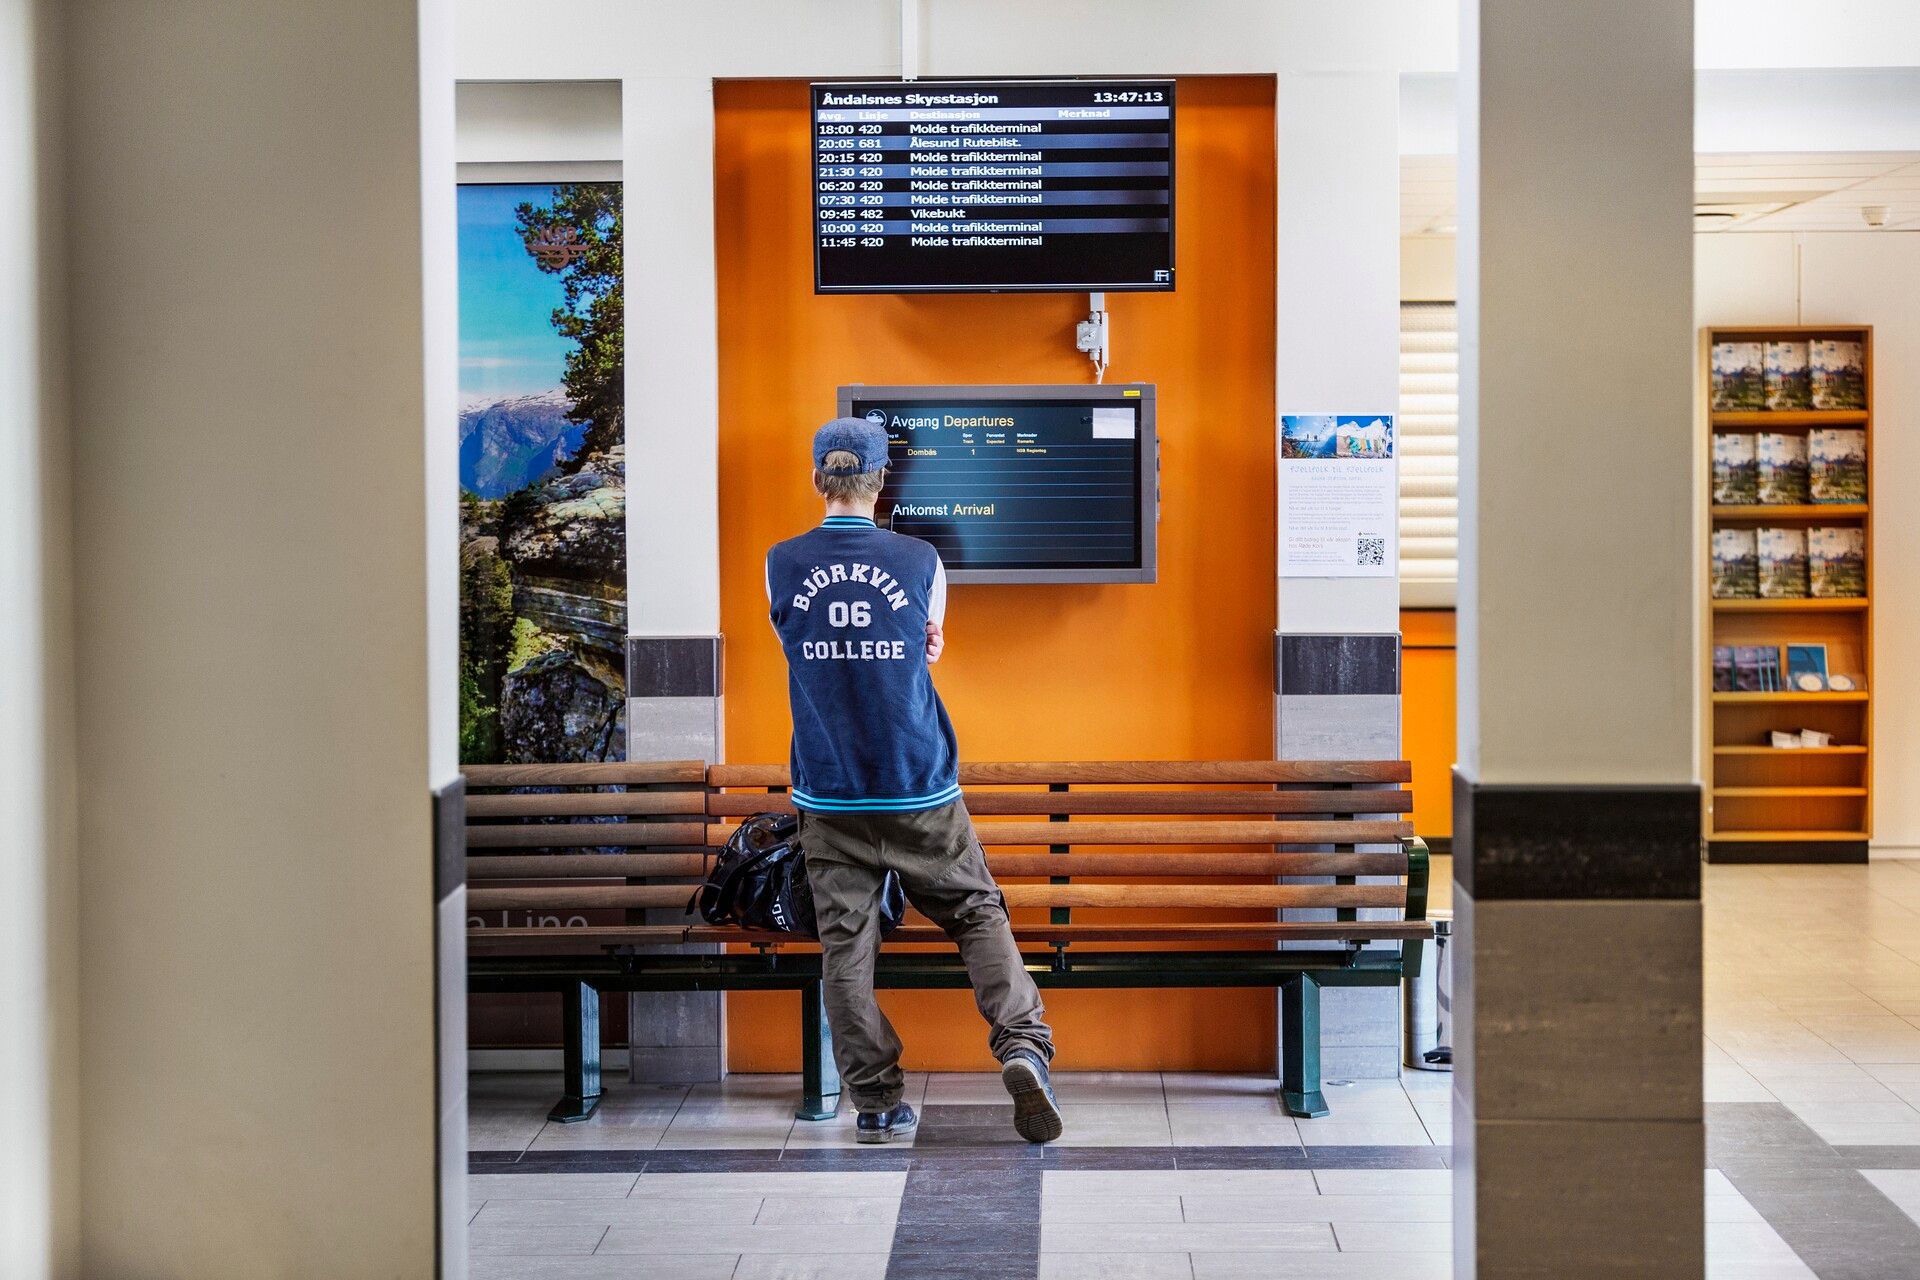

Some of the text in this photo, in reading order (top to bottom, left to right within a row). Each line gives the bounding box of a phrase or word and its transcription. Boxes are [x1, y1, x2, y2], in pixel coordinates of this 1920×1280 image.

[822, 92, 999, 106] Åndalsnes Skysstasjon
[1093, 92, 1163, 103] 13:47:13
[818, 112, 846, 121] Avg.
[859, 111, 889, 121] Linje
[910, 110, 981, 121] Destinasjon
[1058, 109, 1111, 118] Merknad
[819, 123, 1042, 134] 18:00 420 Molde trafikkterminal
[819, 137, 1022, 148] 20:05 681 Ålesund Rutebilst.
[819, 152, 1042, 163] 20:15 420 Molde trafikkterminal
[819, 166, 1042, 177] 21:30 420 Molde trafikkterminal
[819, 180, 1042, 191] 06:20 420 Molde trafikkterminal
[820, 194, 1042, 205] 07:30 420 Molde trafikkterminal
[820, 209, 966, 219] 09:45 482 Vikebukt
[821, 222, 1042, 233] 10:00 420 Molde trafikkterminal
[540, 225, 577, 242] NSB
[821, 236, 1042, 247] 11:45 420 Molde trafikkterminal
[891, 415, 1015, 430] Avgang Departures
[907, 448, 938, 456] Dombås
[971, 448, 975, 456] 1
[892, 503, 995, 516] Ankomst Arrival
[792, 563, 910, 612] BJÖRKVIN
[828, 600, 872, 628] 06
[802, 640, 906, 660] COLLEGE
